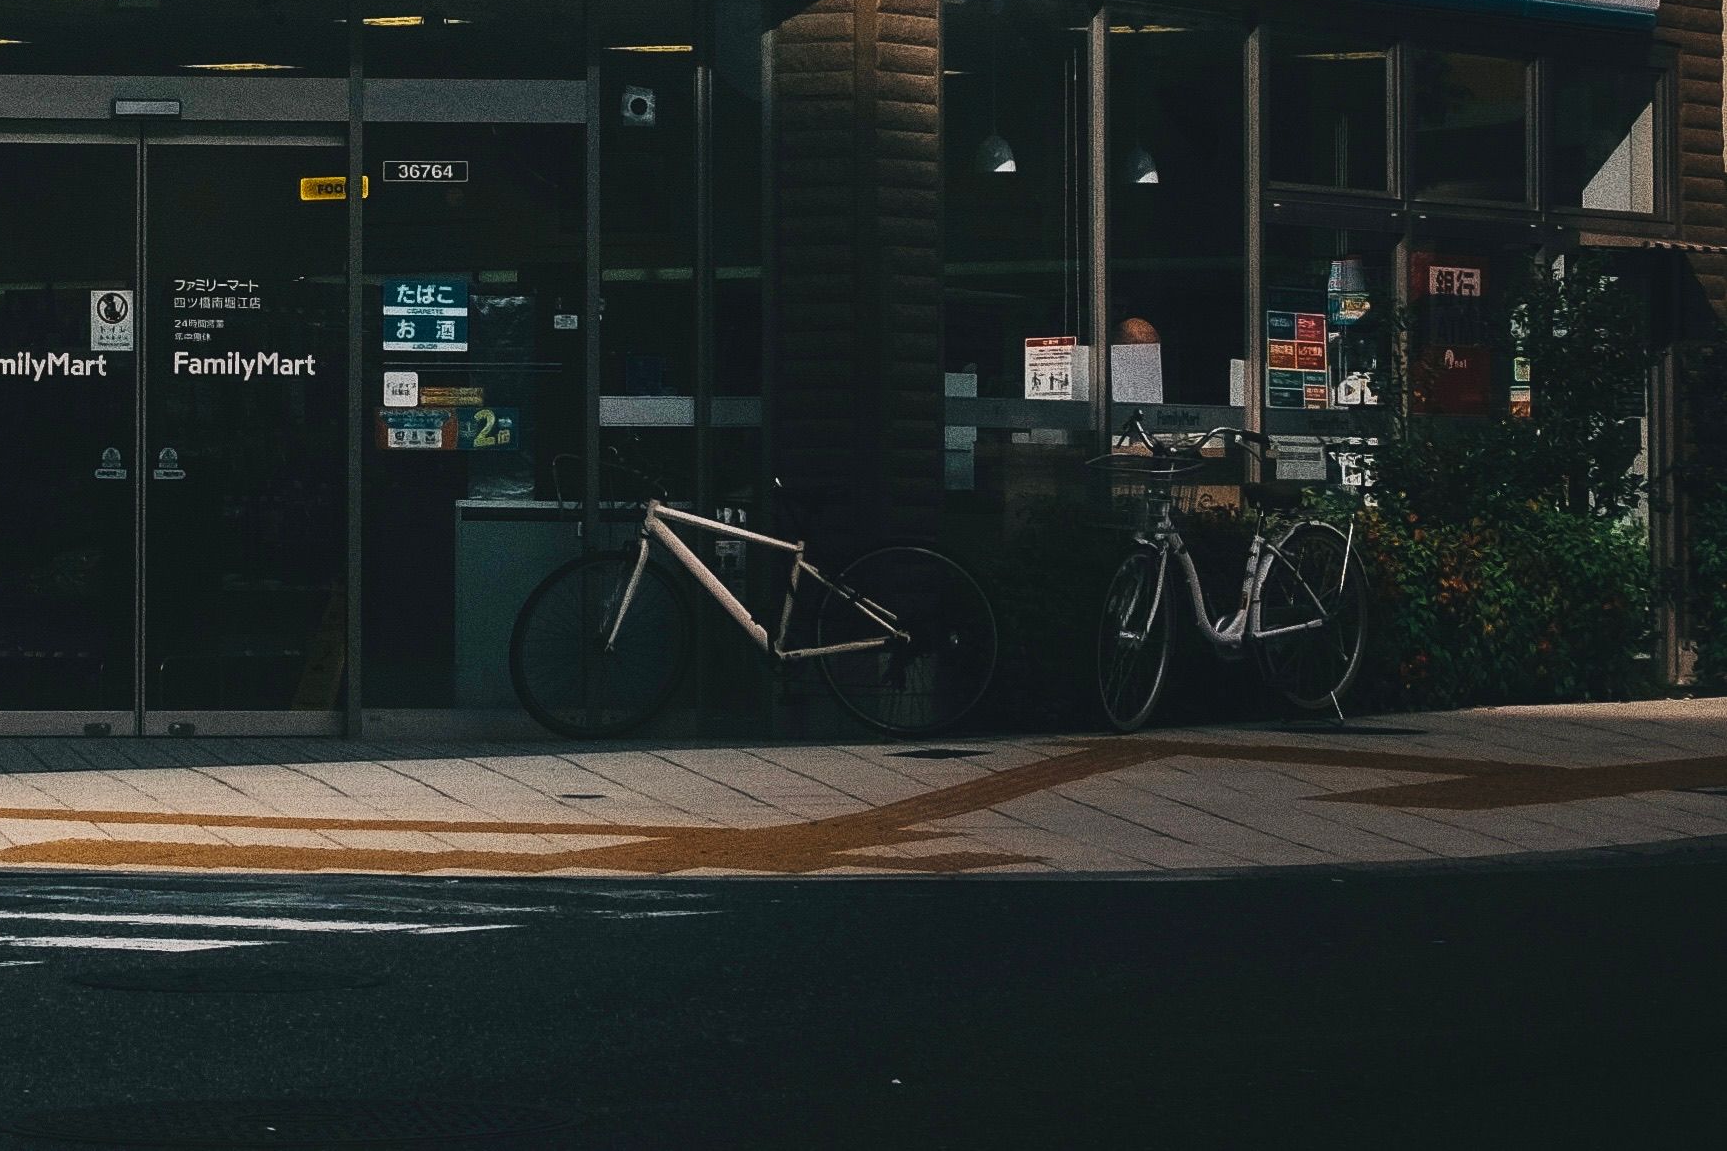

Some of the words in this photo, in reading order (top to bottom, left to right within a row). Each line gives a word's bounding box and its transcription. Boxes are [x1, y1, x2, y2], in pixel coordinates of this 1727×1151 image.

[398, 164, 454, 179] 36764
[174, 279, 259, 293] ファミリーマート
[396, 284, 455, 305] たばこ
[174, 297, 261, 310] 四ツ橋南堀江店
[173, 351, 316, 381] FamilyMart
